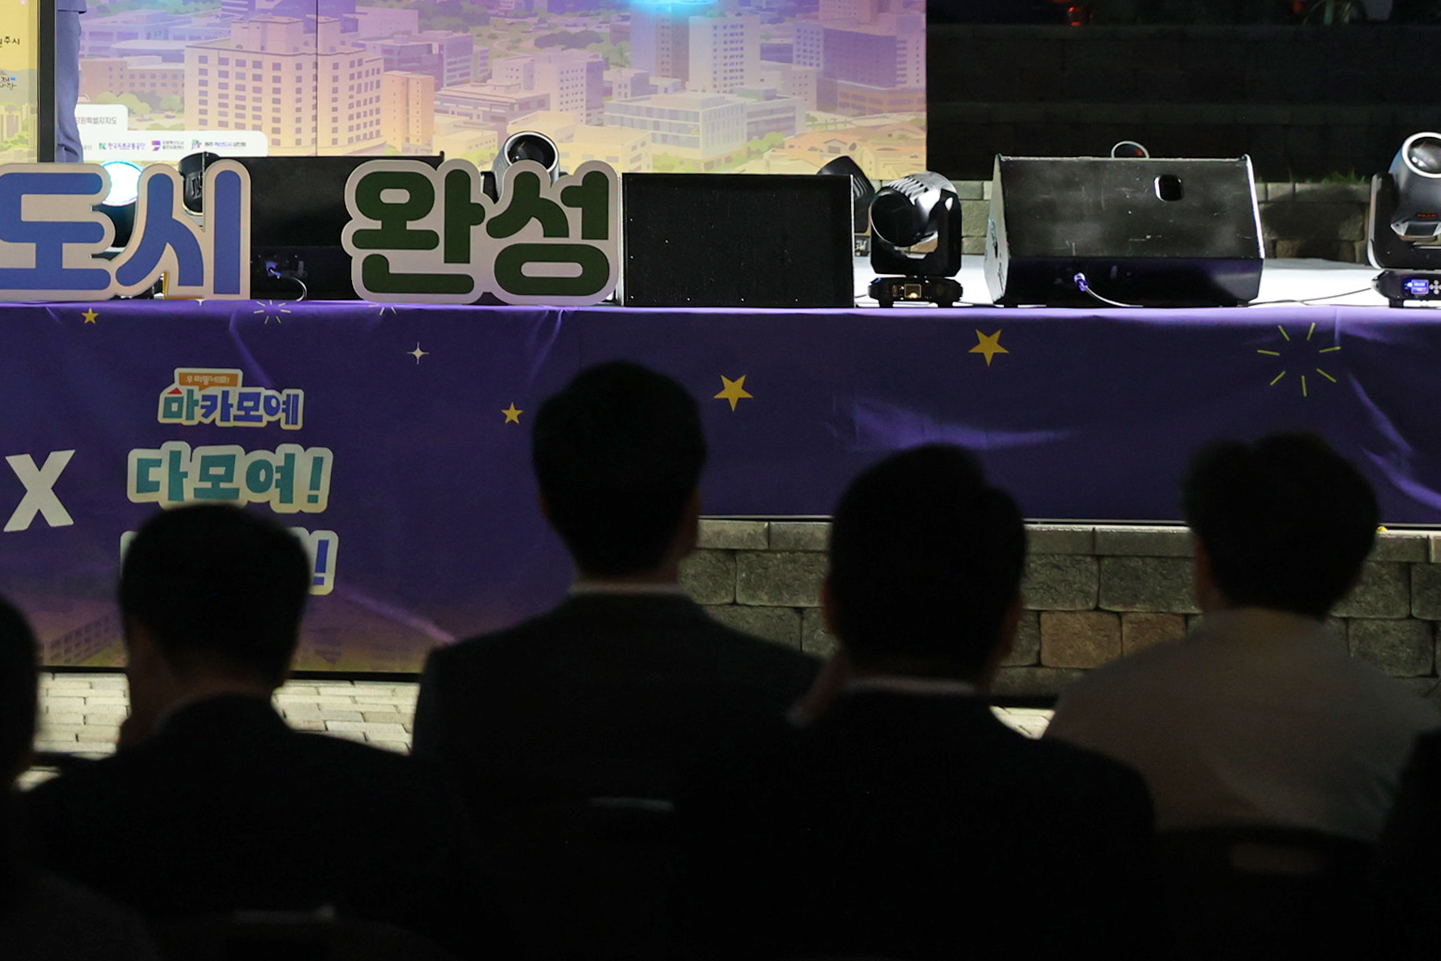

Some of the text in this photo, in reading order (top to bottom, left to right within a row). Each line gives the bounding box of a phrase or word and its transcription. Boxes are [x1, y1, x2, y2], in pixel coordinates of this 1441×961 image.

[351, 168, 611, 296] 완성
[3, 449, 75, 532] X
[135, 449, 325, 505] 다모여!
